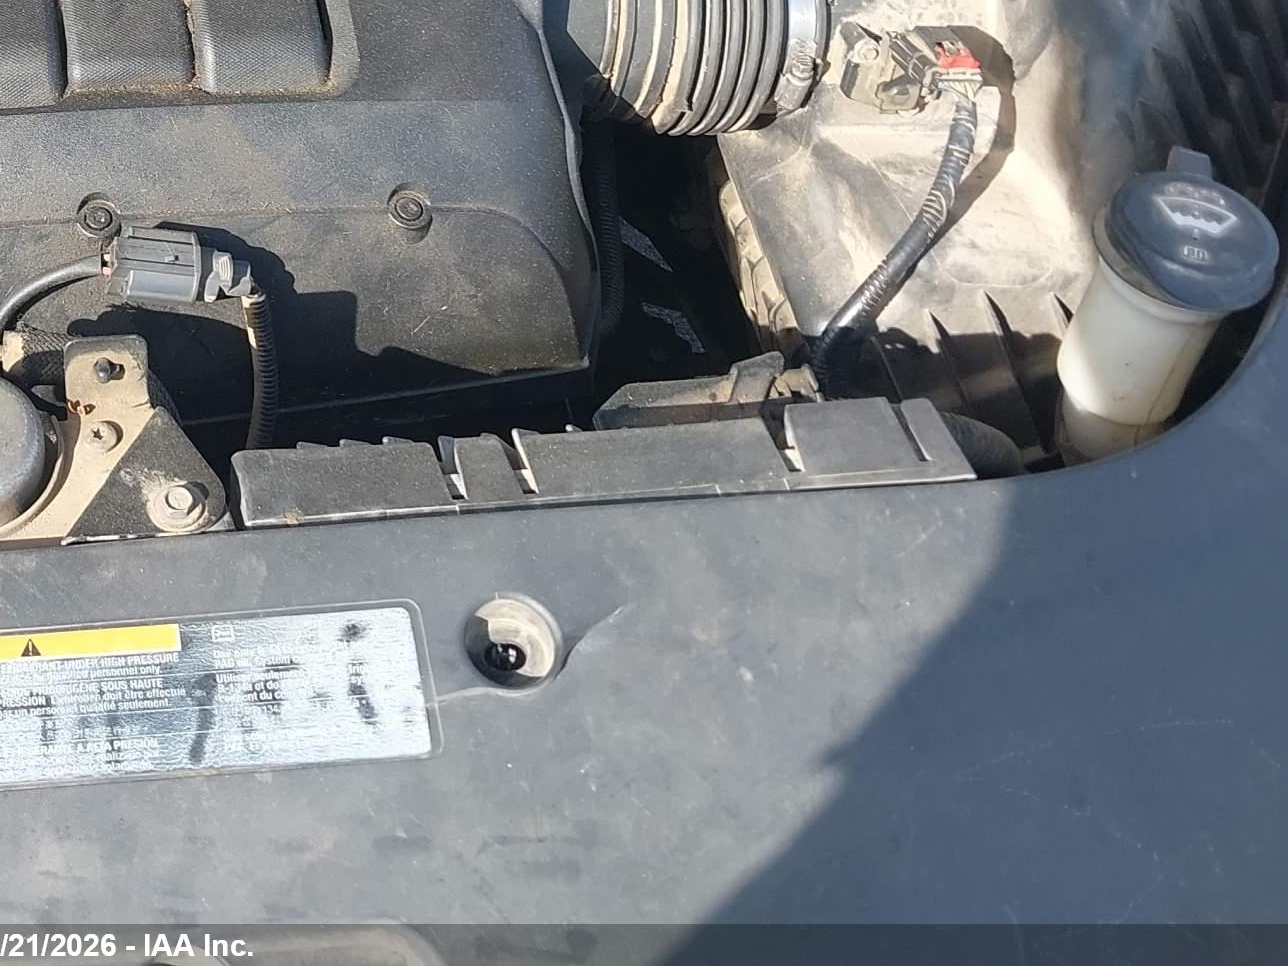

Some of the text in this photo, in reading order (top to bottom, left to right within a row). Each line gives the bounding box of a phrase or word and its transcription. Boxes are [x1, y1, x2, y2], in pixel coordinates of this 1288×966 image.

[101, 655, 125, 669] HIGH
[127, 651, 180, 667] PRESSURE
[90, 665, 137, 681] personnel
[101, 680, 128, 692] SOUS
[129, 677, 163, 690] HAUTE
